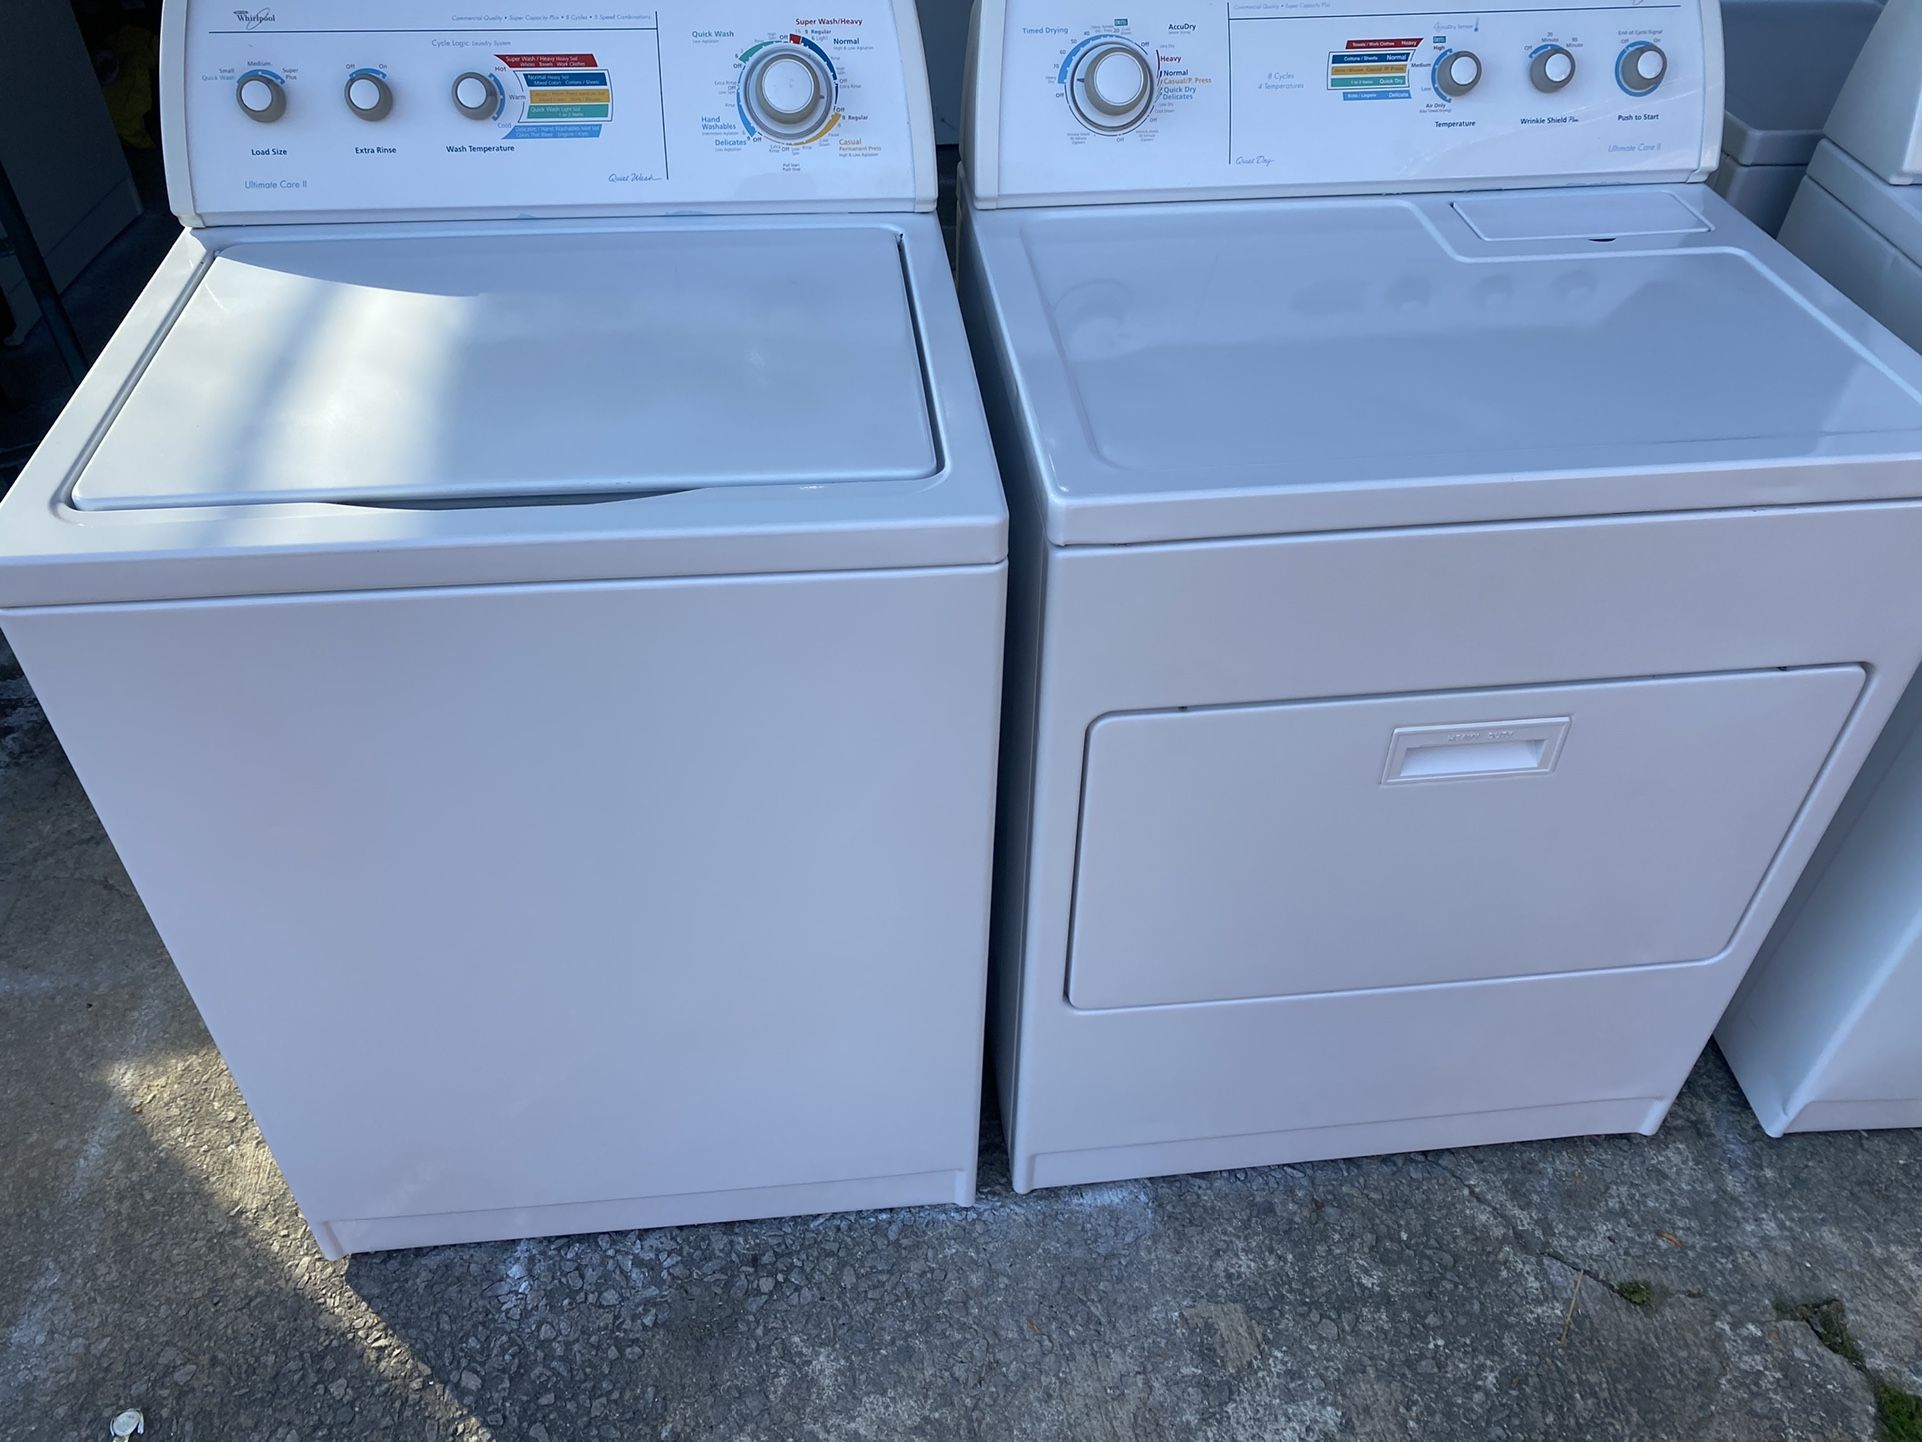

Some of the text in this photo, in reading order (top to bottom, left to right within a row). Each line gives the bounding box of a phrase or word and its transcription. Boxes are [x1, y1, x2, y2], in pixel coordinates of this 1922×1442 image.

[236, 13, 276, 23] Whirlpool
[484, 14, 503, 22] Quality
[795, 18, 863, 26] Super Wash/Heavy
[1046, 26, 1069, 35] Drying
[1168, 23, 1197, 31] AccuDry
[692, 30, 712, 38] Quick
[431, 39, 450, 48] Cycle
[452, 39, 470, 48] Logic
[1160, 55, 1181, 63] Heavy
[282, 67, 299, 75] Super
[1273, 72, 1294, 80] Cycles
[1163, 86, 1197, 94] Quick Dry
[1264, 82, 1304, 90] Temperatures
[1520, 117, 1547, 125] Wrinkle
[1548, 116, 1567, 124] Shield
[839, 138, 862, 146] Casual
[251, 148, 287, 156] Load Size
[446, 145, 515, 154] Wash Temperature
[1608, 144, 1636, 152] Ultimate
[1235, 155, 1275, 167] Quiet Dry
[608, 173, 662, 182] Quiet Wash
[244, 180, 277, 189] Ultimate
[280, 180, 299, 189] Care
